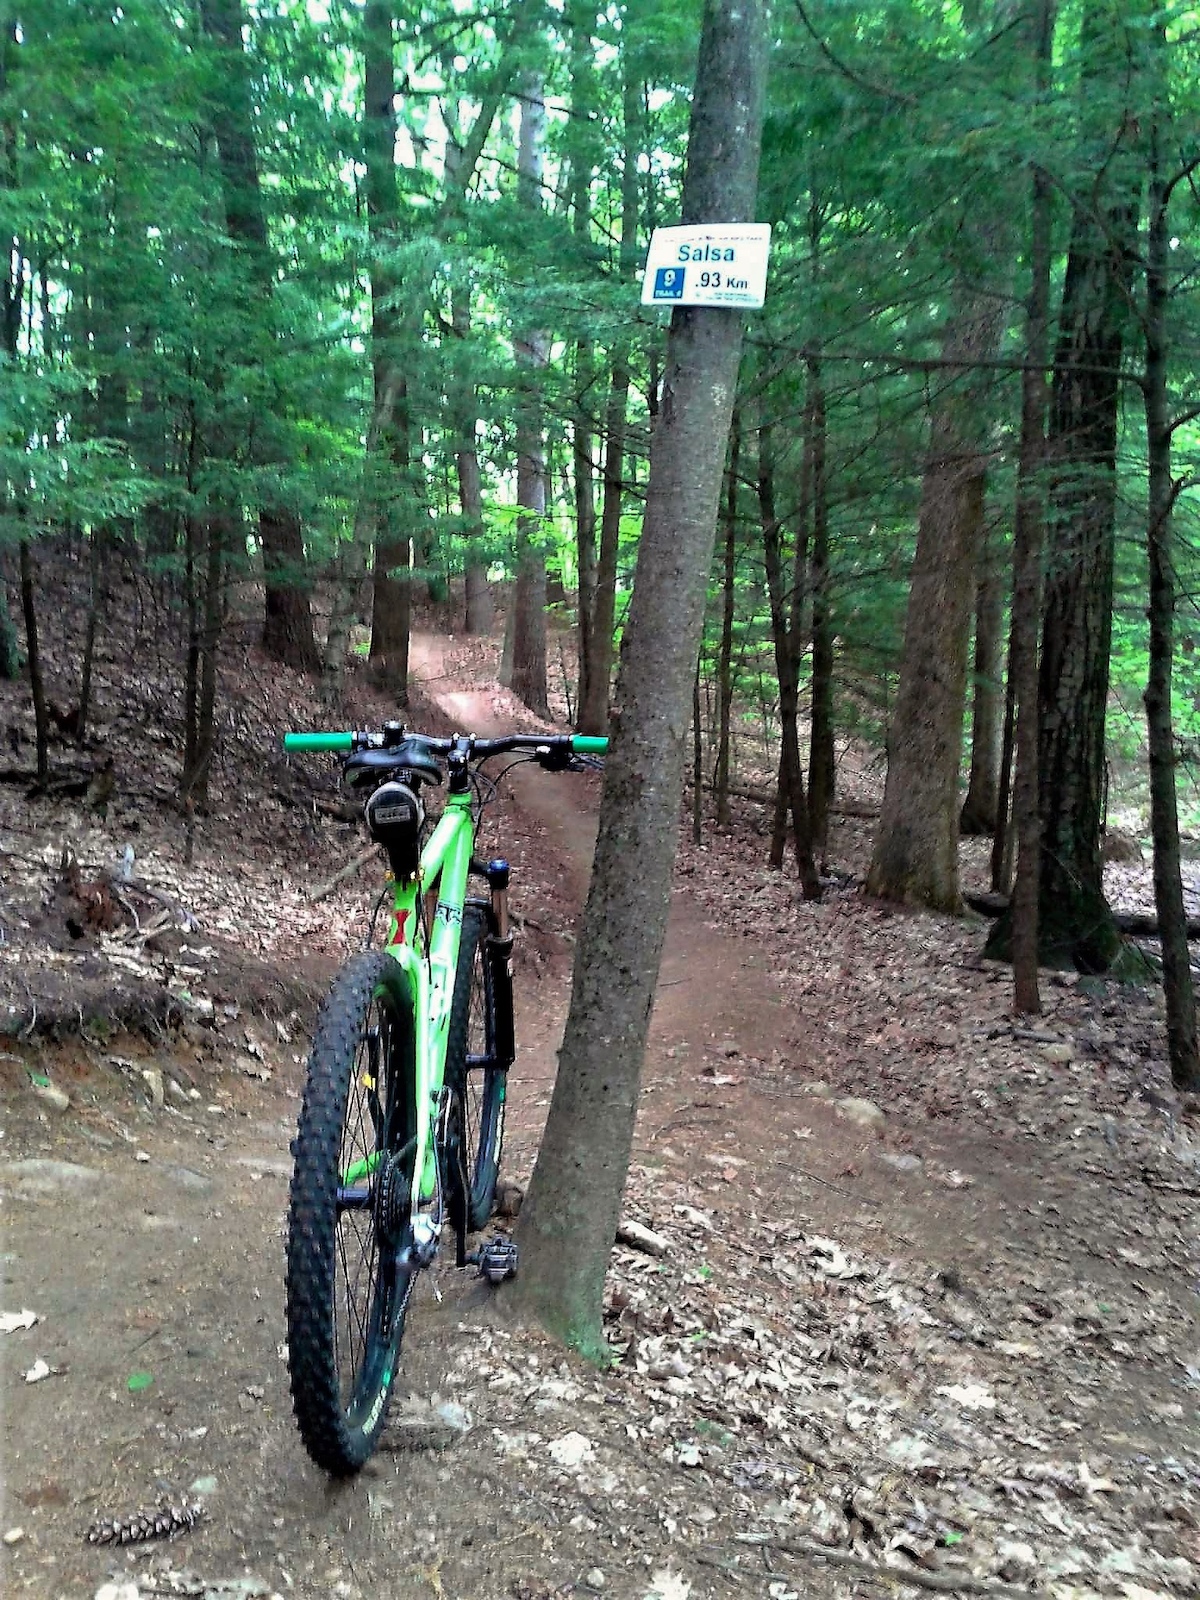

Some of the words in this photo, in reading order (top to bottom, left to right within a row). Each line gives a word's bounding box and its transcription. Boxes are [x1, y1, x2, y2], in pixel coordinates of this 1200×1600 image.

[678, 244, 734, 261] Salsa
[664, 269, 676, 287] 9
[695, 272, 720, 288] .93
[727, 278, 748, 288] Km
